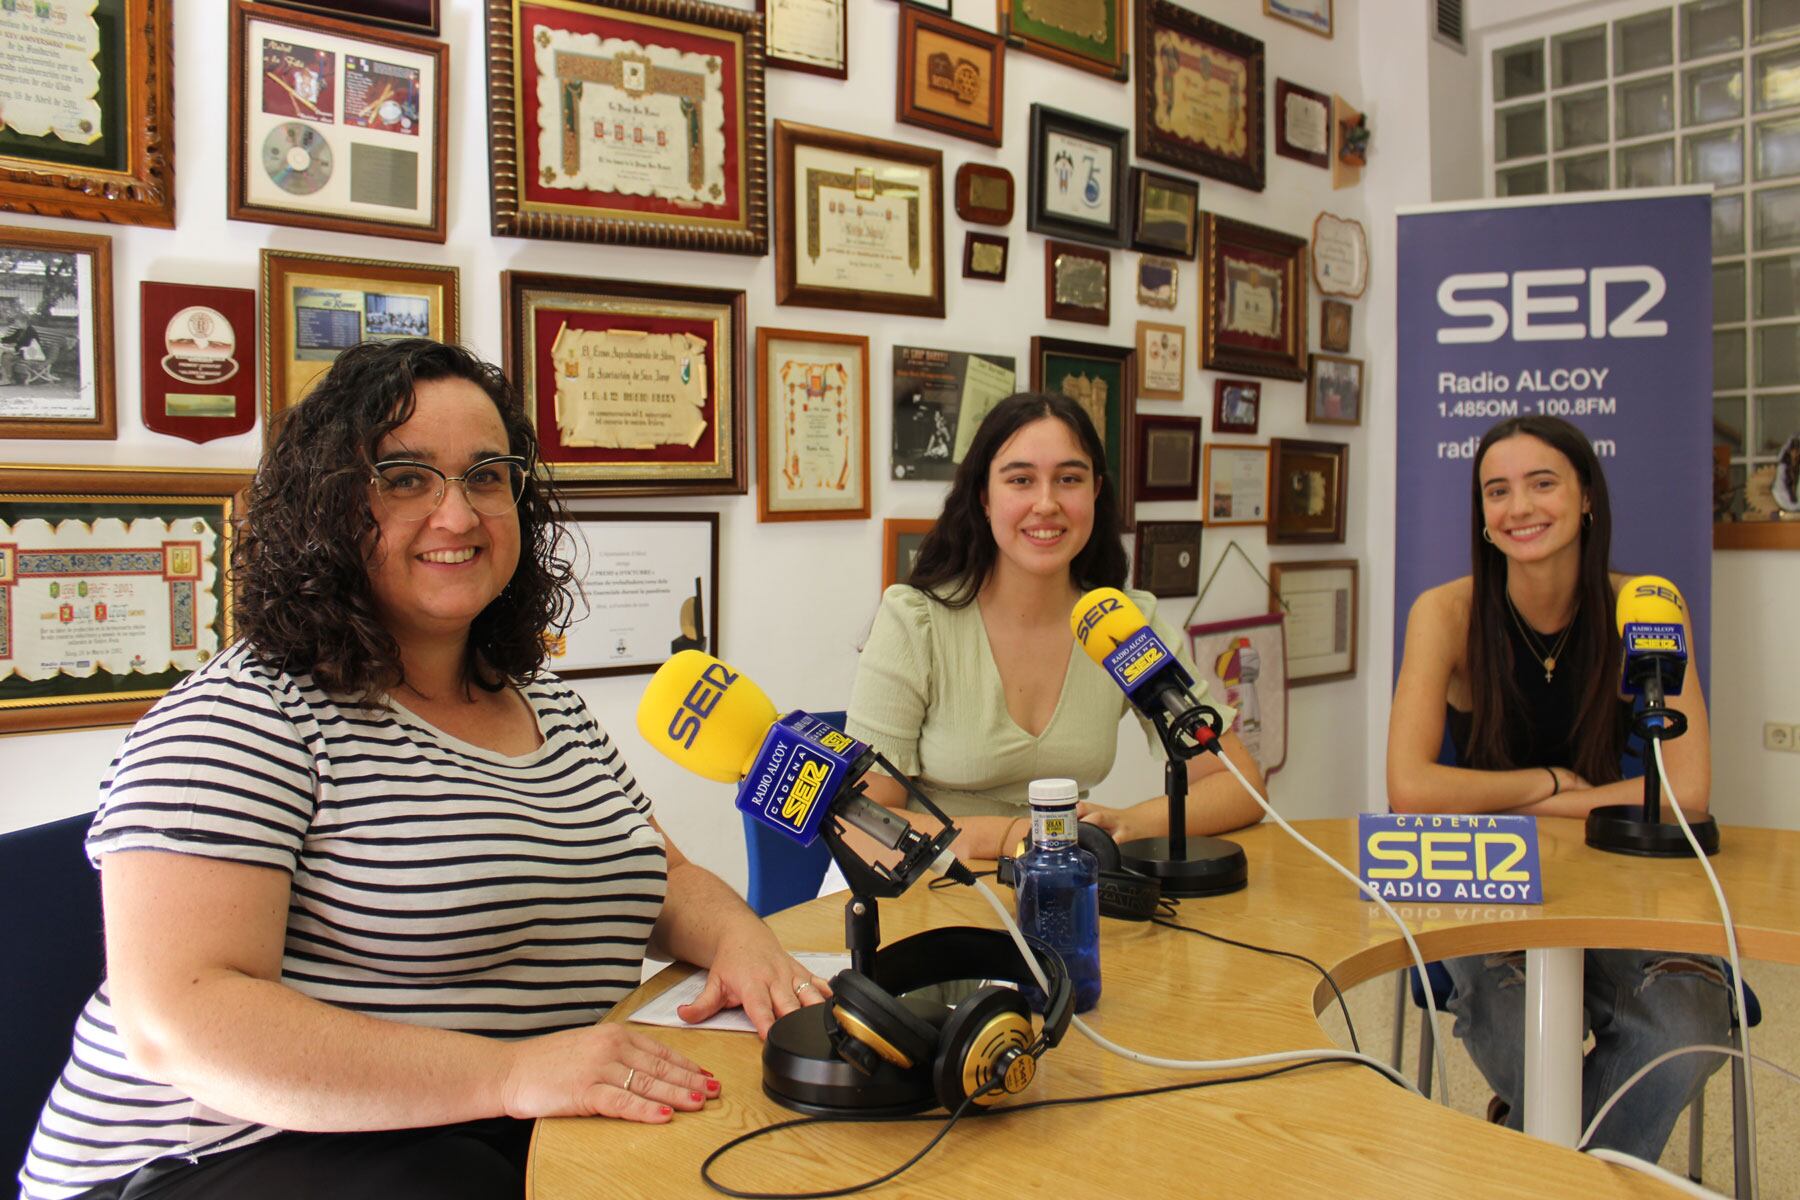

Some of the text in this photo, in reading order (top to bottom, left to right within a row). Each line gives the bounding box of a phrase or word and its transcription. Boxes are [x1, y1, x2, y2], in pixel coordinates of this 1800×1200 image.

[1437, 265, 1668, 344] SER
[1438, 368, 1609, 394] Radio ALCOY
[1536, 398, 1616, 416] 100.8FM
[1077, 597, 1125, 646] SER
[1111, 633, 1148, 665] RADIO ALCOY
[1123, 647, 1164, 683] SER
[1634, 638, 1678, 650] SER
[667, 662, 739, 750] SER
[751, 740, 789, 806] RADIO ALCOY
[771, 752, 807, 815] CADENA
[780, 759, 829, 828] SER
[1396, 817, 1498, 828] CADENA
[1367, 831, 1530, 881] SER
[1367, 881, 1531, 900] RADIO ALCOY
